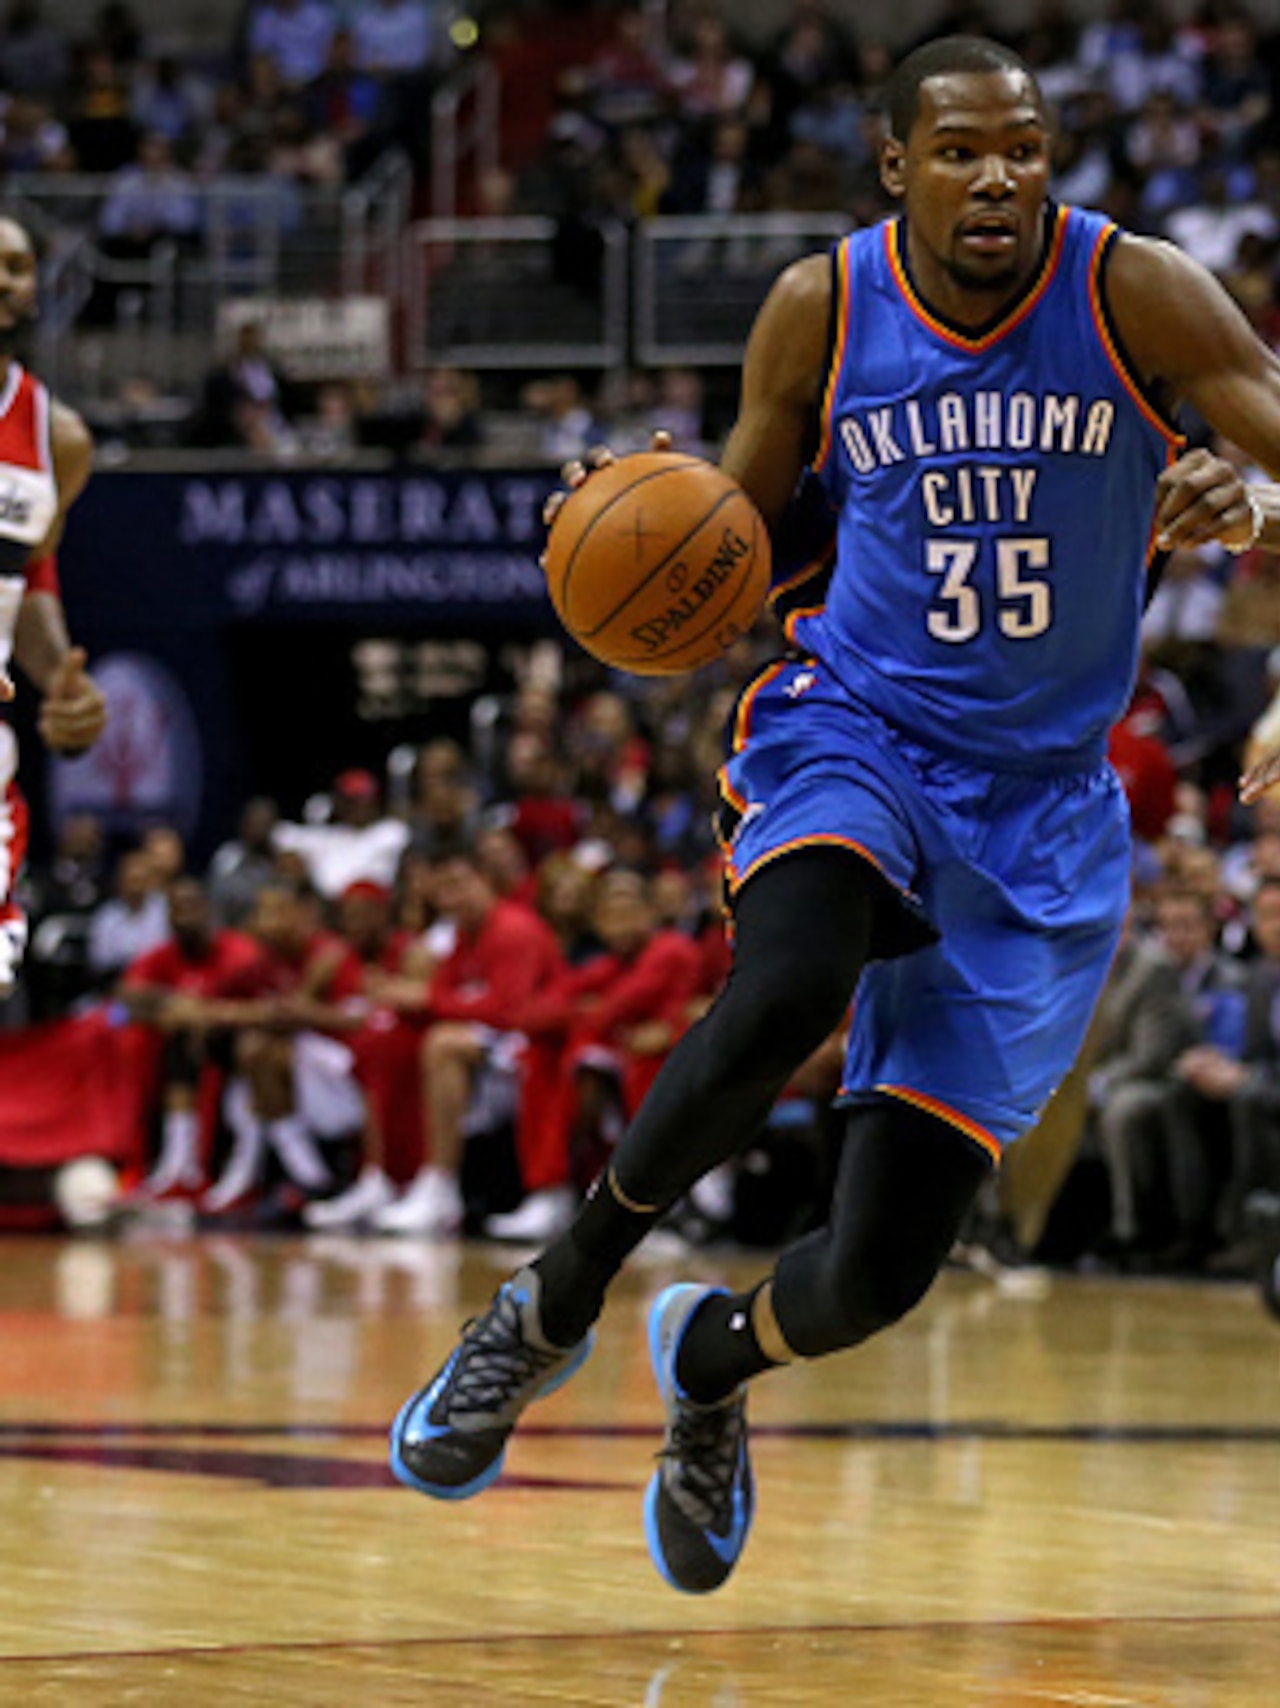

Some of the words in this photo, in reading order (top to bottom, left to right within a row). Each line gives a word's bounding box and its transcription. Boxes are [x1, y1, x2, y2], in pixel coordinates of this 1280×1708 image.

[839, 389, 1115, 475] OKLAHOMA
[180, 477, 546, 545] MASERAT
[921, 464, 1037, 527] CITY
[630, 526, 750, 653] SPALDING
[924, 537, 1051, 644] 35
